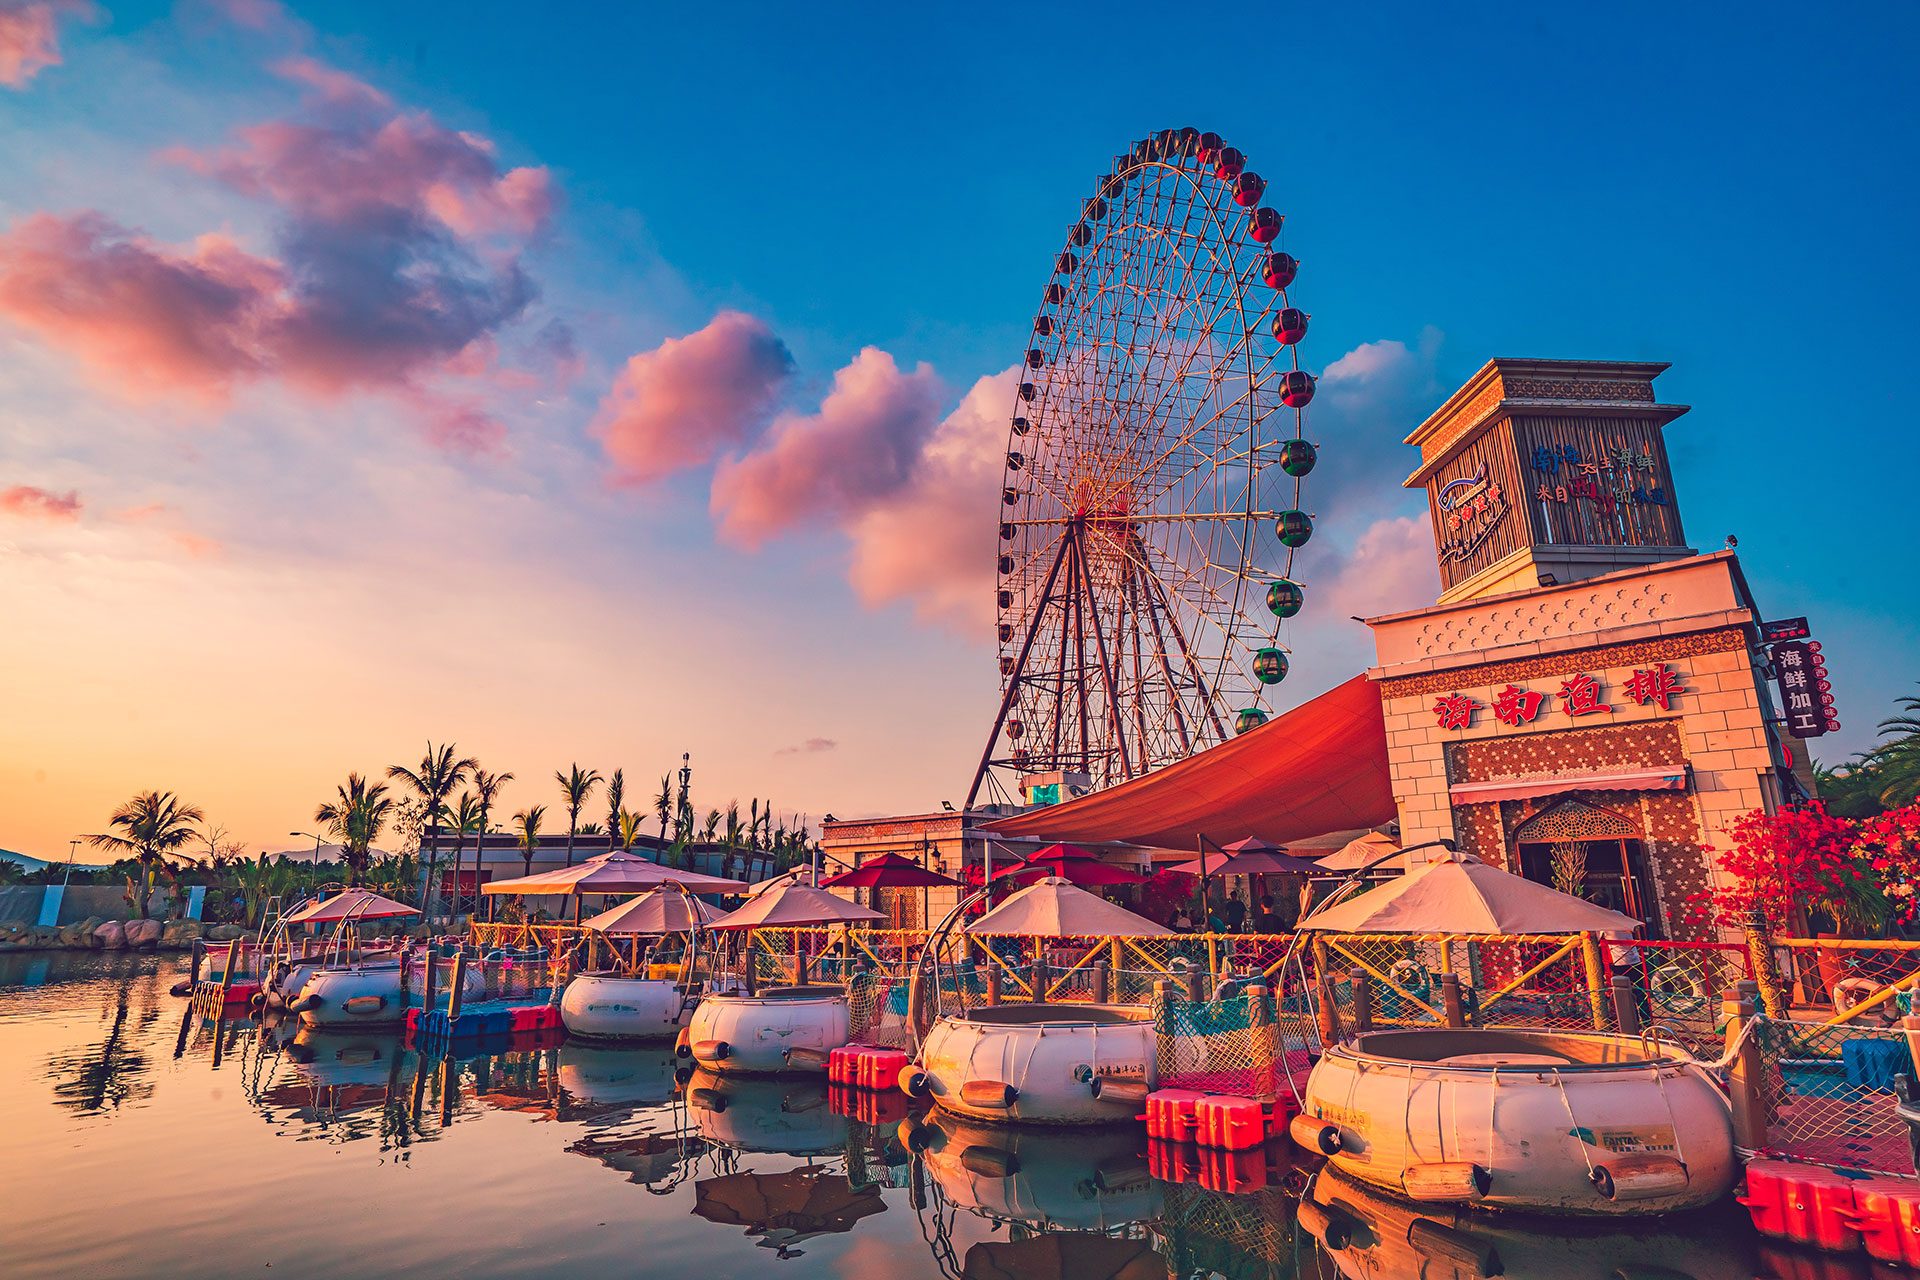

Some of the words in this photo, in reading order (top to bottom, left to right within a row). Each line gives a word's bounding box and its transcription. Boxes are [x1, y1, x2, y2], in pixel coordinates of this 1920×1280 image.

[1432, 663, 1685, 730] 海南渔排
[1780, 650, 1817, 729] 海鲜加工
[1809, 643, 1840, 732] 来自西沙的味道
